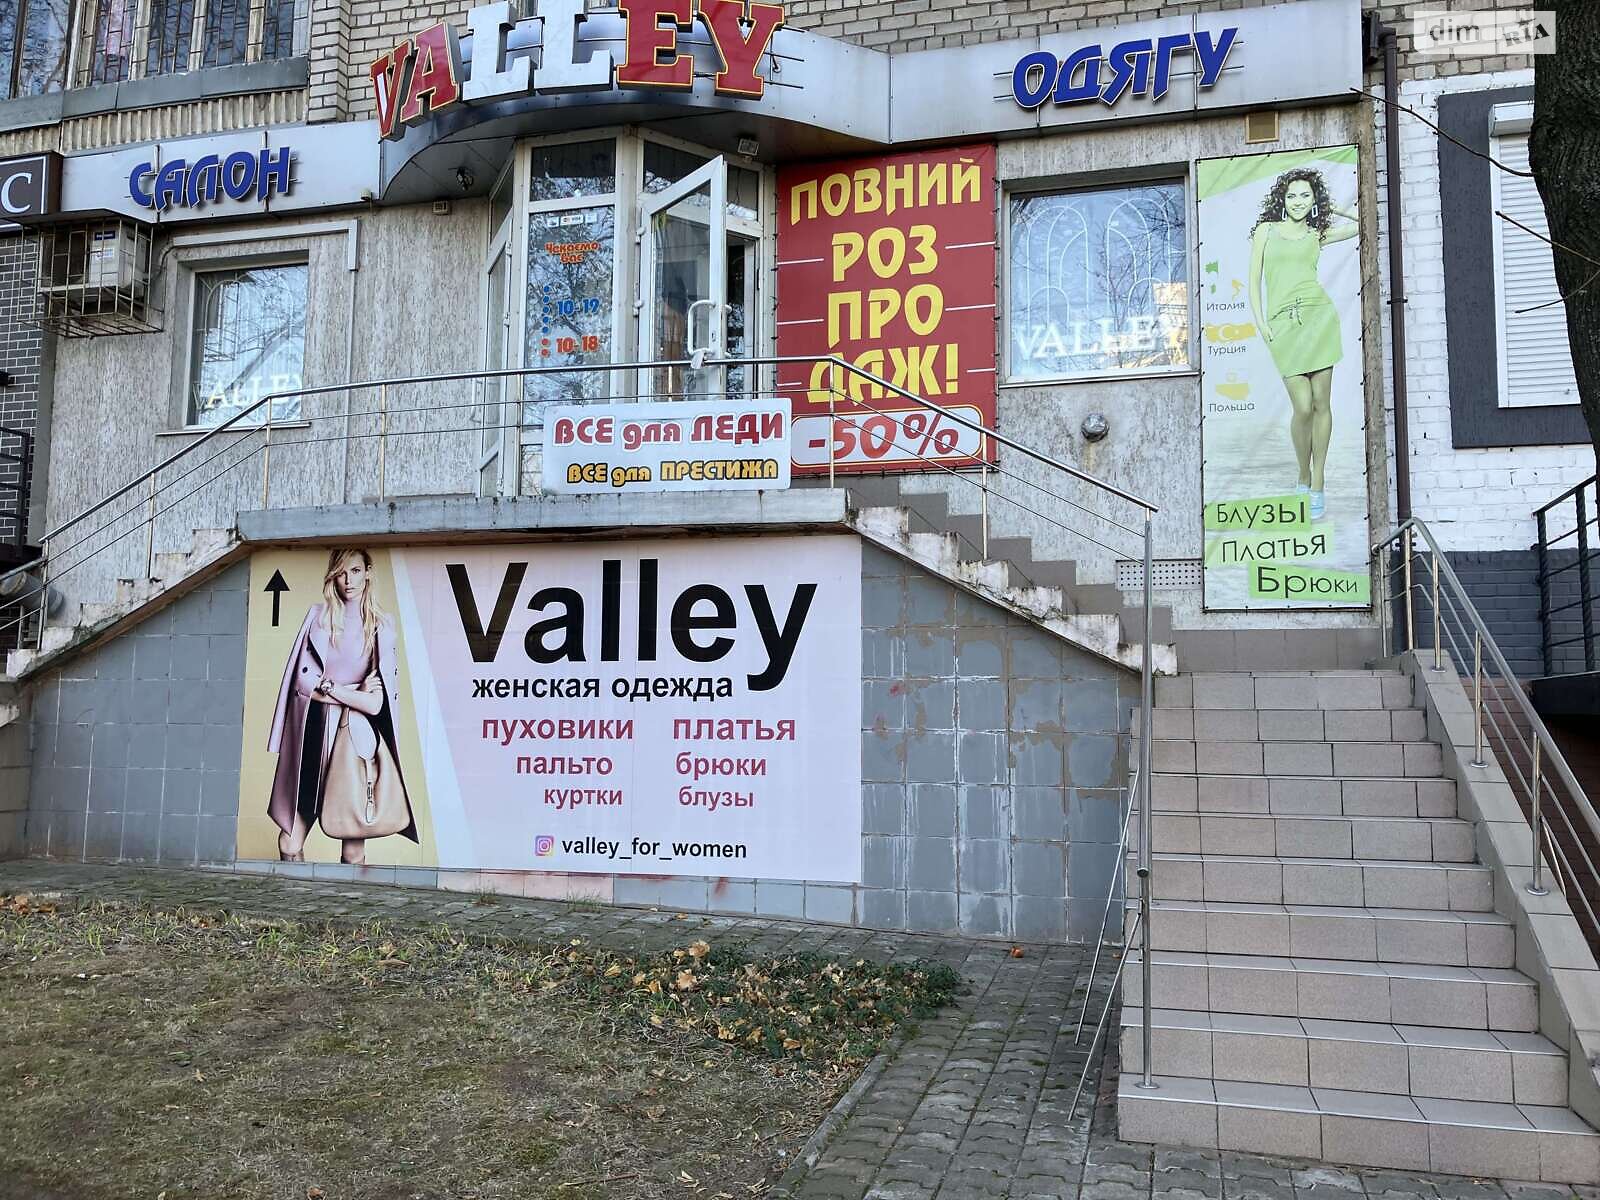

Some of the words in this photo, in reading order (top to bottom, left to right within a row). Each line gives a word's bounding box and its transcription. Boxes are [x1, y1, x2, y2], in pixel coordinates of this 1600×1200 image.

[369, 0, 785, 139] VALLEY
[1012, 27, 1239, 109] ОДЯГУ
[129, 146, 291, 212] САЛОН
[790, 157, 982, 226] ПОВНИЙ
[831, 224, 938, 283] РОЗ
[827, 283, 945, 349] ПРО
[1207, 301, 1246, 313] Италия
[1207, 345, 1247, 357] Турция
[806, 343, 960, 406] ДАЖ!
[1209, 402, 1256, 413] Польша
[555, 417, 613, 445] ВСЕ
[691, 412, 784, 445] ЛЕДИ
[567, 463, 608, 484] ВСЕ
[660, 459, 779, 481] ПРЕСТИЖА
[1217, 502, 1305, 528] Блузы
[1222, 534, 1326, 563] Платья
[1258, 566, 1358, 598] Брюки
[445, 558, 818, 692] Valley
[472, 675, 600, 699] женская
[611, 676, 733, 702] одежда
[482, 718, 634, 746] пуховики
[673, 718, 796, 741] платья
[516, 755, 613, 775] пальто
[675, 751, 767, 780] брюки
[543, 787, 623, 809] куртки
[678, 785, 754, 811] блузы
[562, 836, 748, 861] valley_for_women
